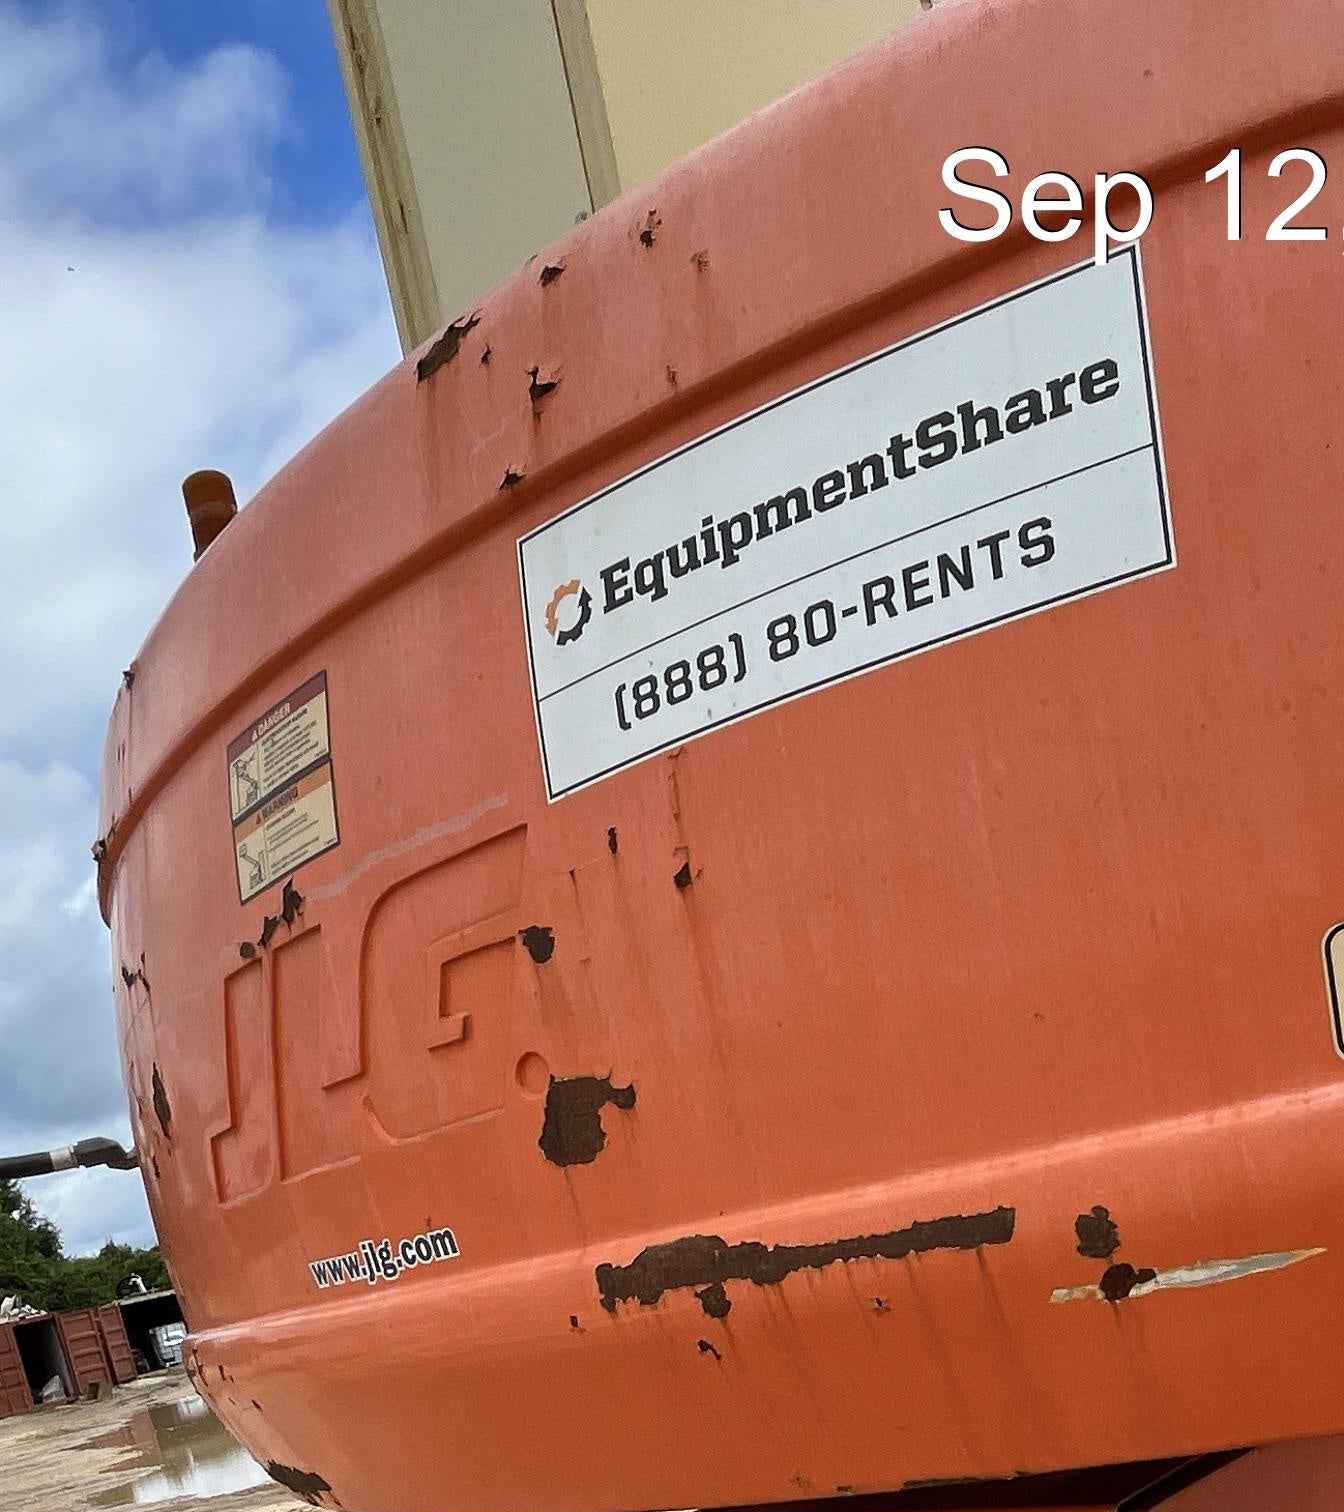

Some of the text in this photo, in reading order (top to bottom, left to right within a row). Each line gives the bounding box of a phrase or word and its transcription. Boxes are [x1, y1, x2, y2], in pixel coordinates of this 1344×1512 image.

[599, 357, 1121, 614] EquipmentShare
[614, 515, 1057, 731] (888) 80-RENTS
[257, 702, 292, 737] DANGER
[310, 1228, 459, 1287] www.jlg.com
